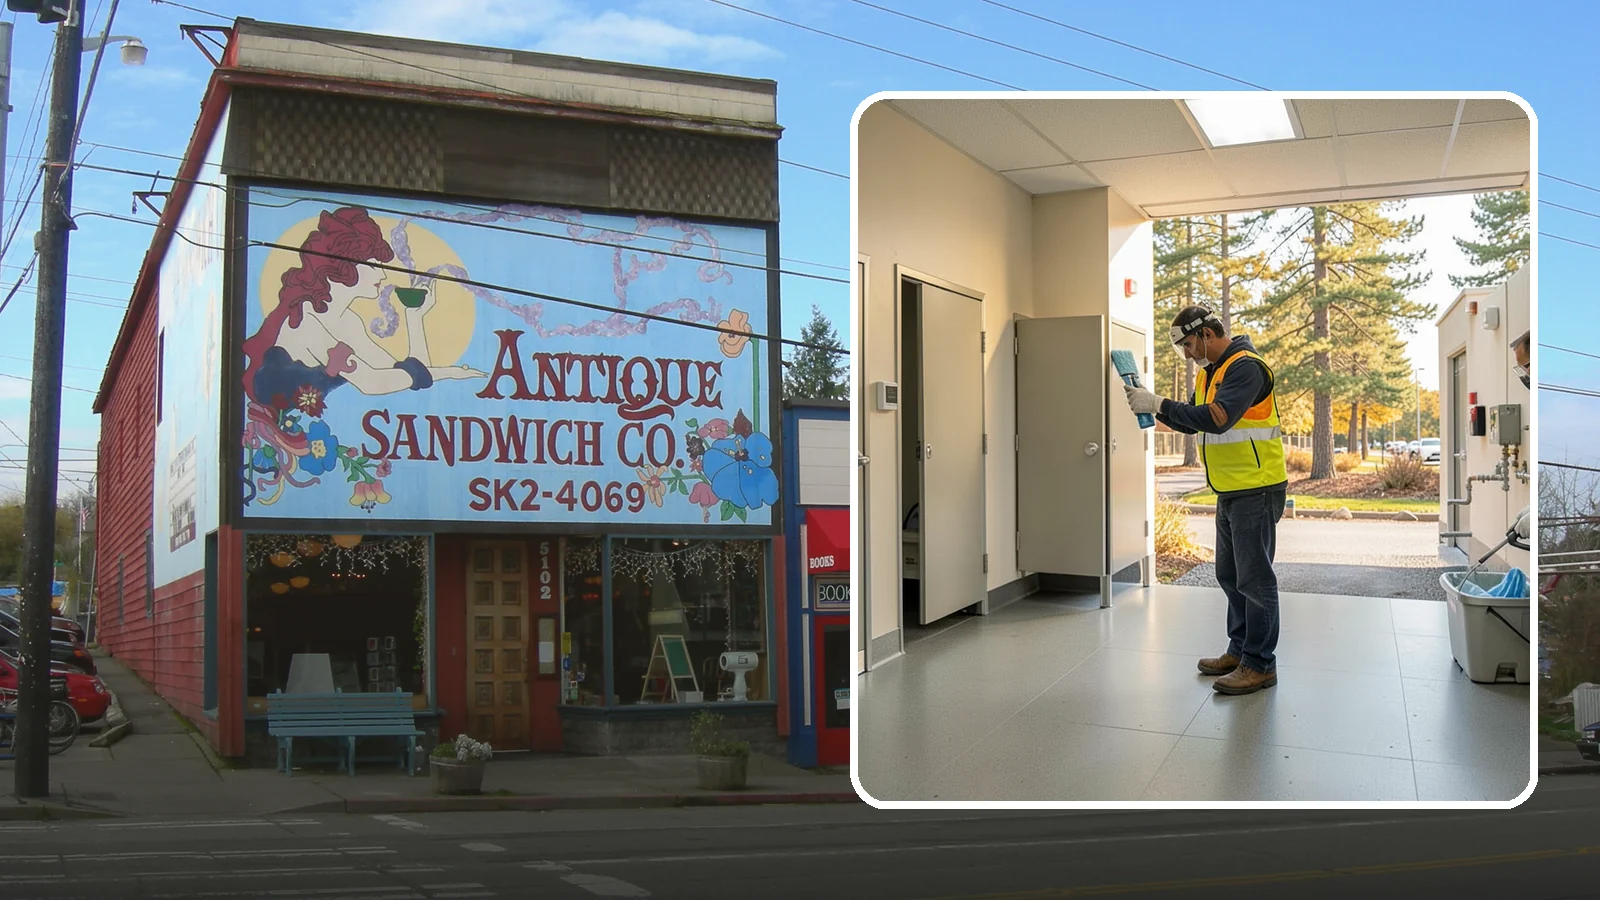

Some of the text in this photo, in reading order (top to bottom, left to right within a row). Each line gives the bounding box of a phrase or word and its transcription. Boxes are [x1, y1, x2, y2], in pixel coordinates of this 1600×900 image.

[475, 329, 723, 420] ANTIQUE
[361, 409, 685, 468] SANDWICH CO.
[468, 477, 645, 513] SK2-4069
[539, 542, 552, 600] 5102
[809, 555, 835, 569] BOOKS
